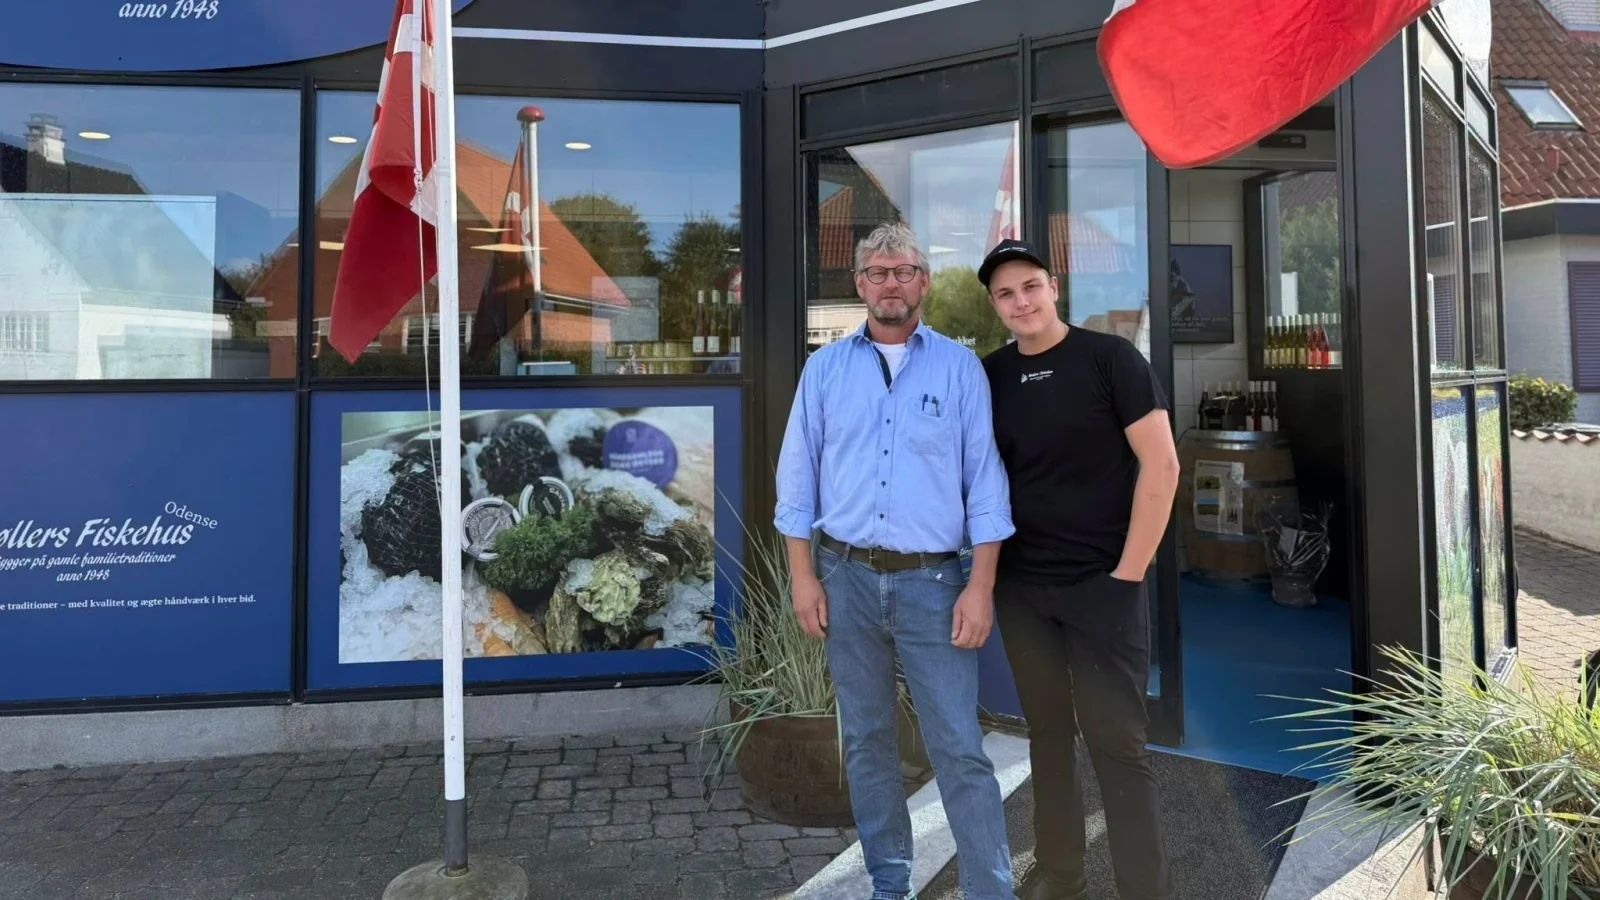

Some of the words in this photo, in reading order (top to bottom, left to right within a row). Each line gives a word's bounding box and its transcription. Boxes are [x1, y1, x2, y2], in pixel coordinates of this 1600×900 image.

[119, 2, 168, 19] anno
[170, 0, 219, 20] 1948
[164, 501, 219, 529] Odense
[75, 516, 194, 548] Fiskehus
[0, 556, 30, 571] ygger
[30, 554, 47, 570] på
[46, 553, 80, 570] gamle
[80, 550, 176, 568] familietraditioner
[56, 572, 83, 582] anno
[84, 568, 110, 581] 1948
[7, 600, 58, 611] traditioner
[68, 599, 88, 609] med
[90, 598, 125, 608] kvalitet
[127, 600, 139, 609] og
[140, 598, 163, 608] ægte
[164, 596, 210, 606] håndværk
[217, 595, 238, 604] hver
[239, 594, 257, 604] bid.
